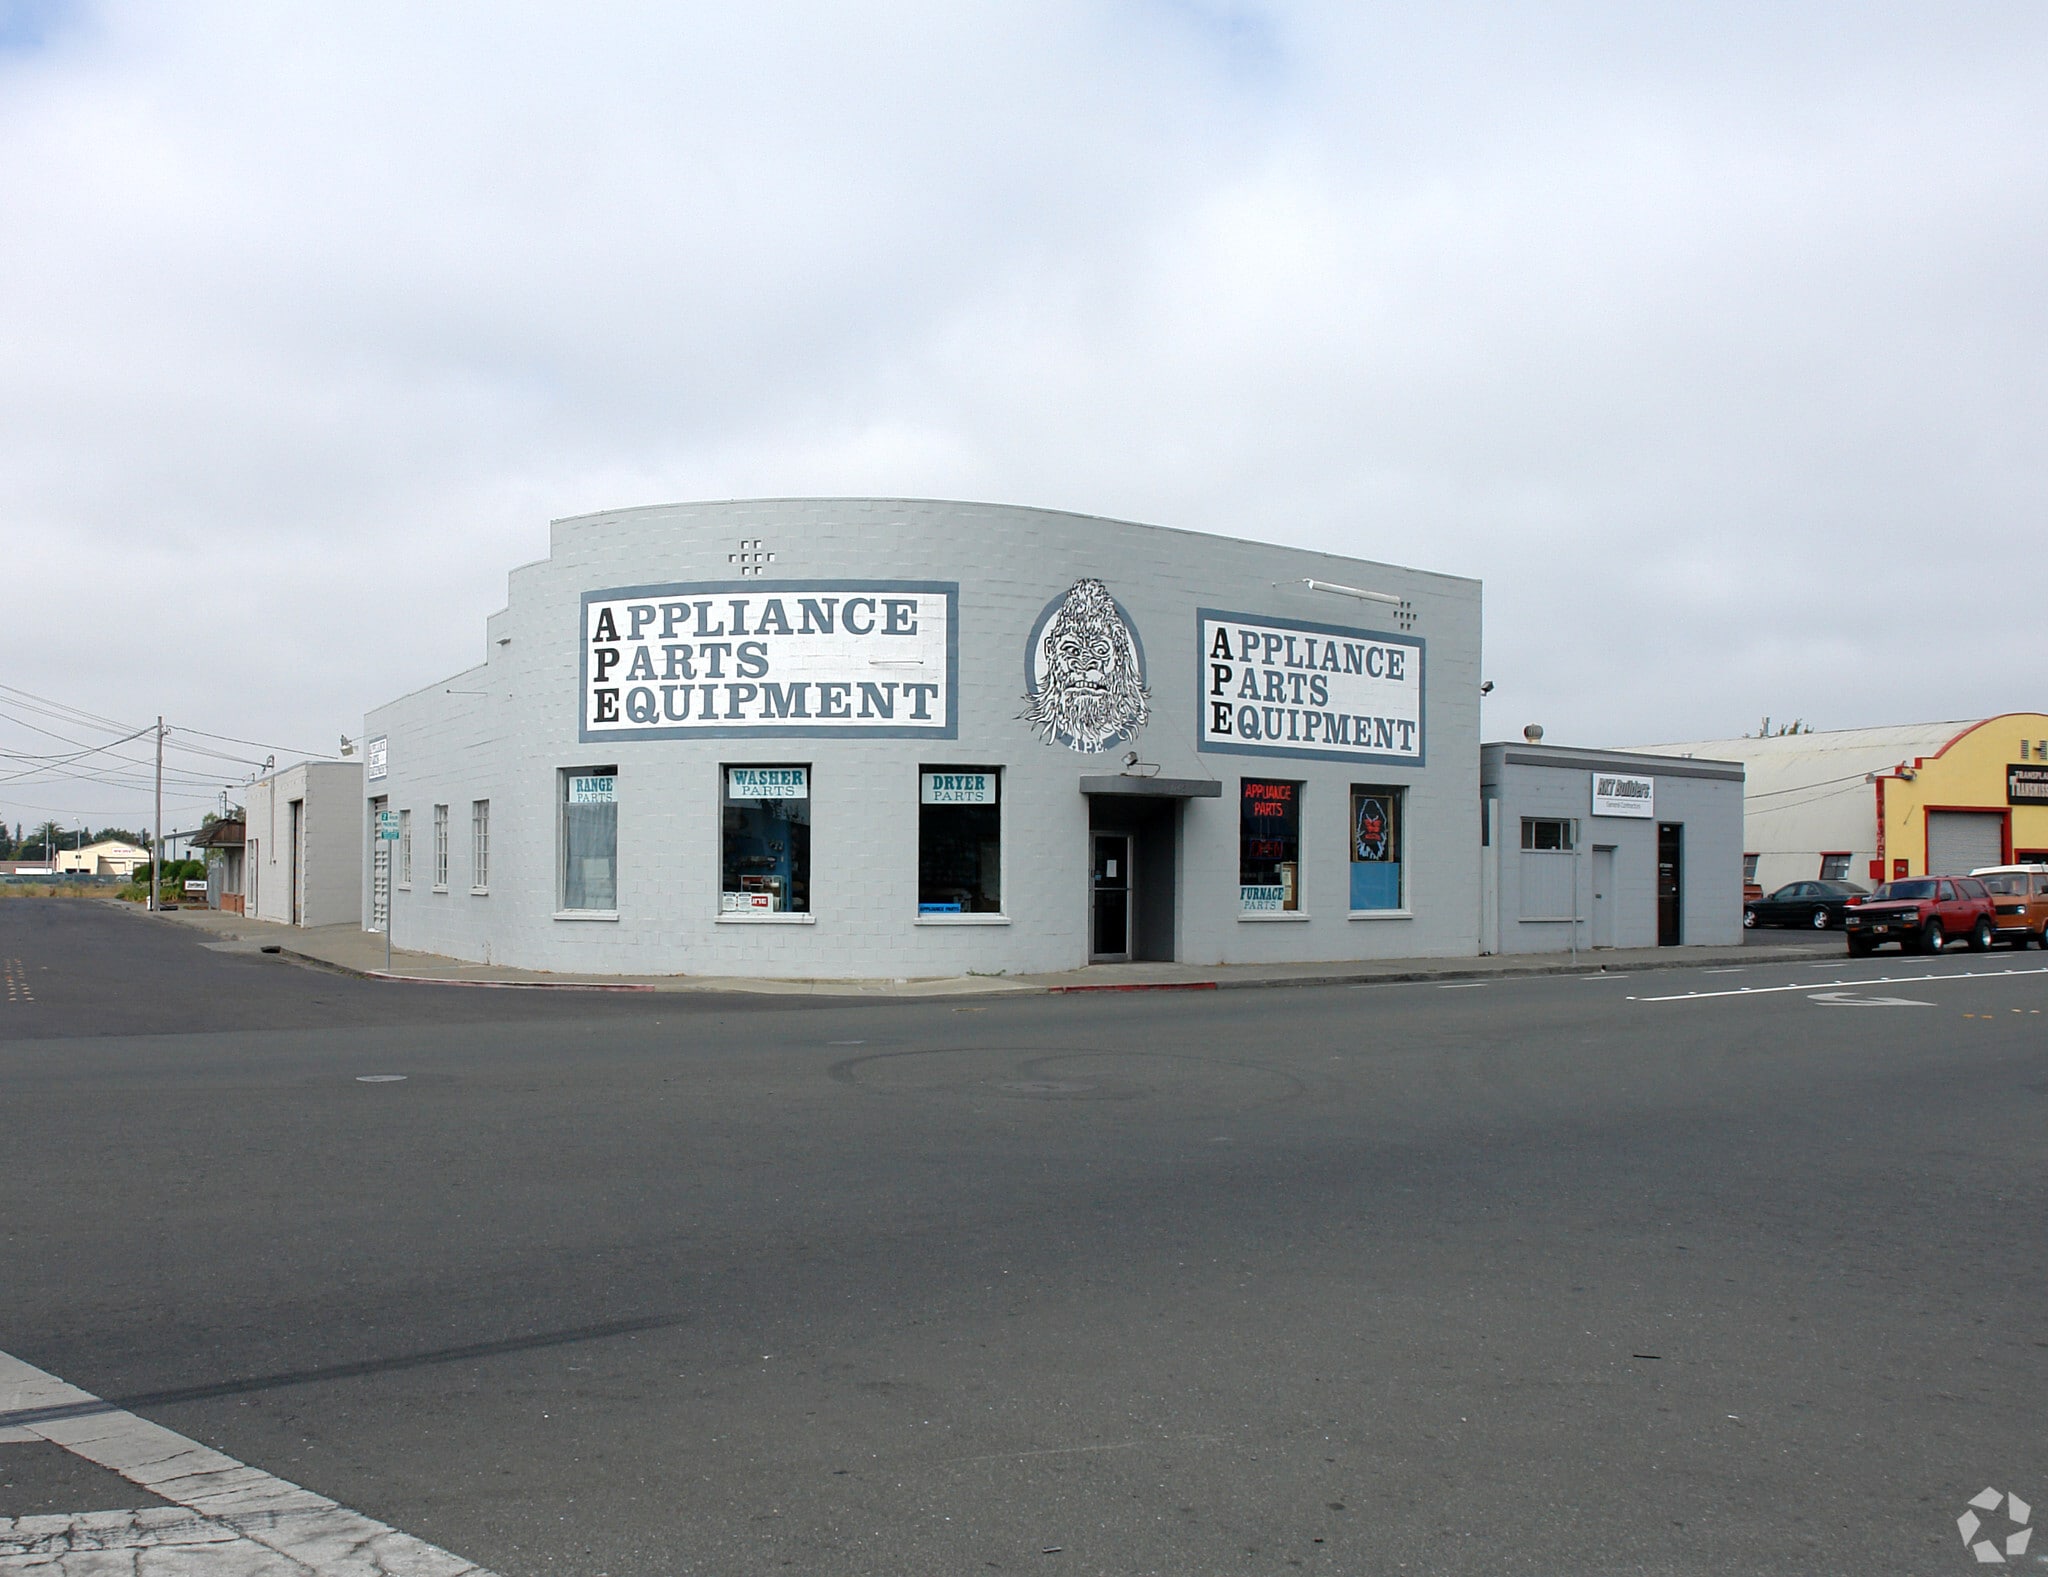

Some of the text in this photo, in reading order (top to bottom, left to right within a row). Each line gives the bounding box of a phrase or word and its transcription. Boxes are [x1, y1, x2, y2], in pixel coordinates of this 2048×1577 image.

[593, 597, 918, 642] APPLIANCE
[593, 641, 769, 682] PARTS
[1210, 627, 1404, 681] APPLIANCE
[1210, 663, 1329, 707] PARTS
[593, 682, 938, 724] EQUIPMENT
[1210, 701, 1415, 751] EQUIPMENT
[576, 777, 613, 792] RANGE
[733, 770, 803, 785] WASHER
[932, 775, 985, 790] DRYER
[577, 793, 613, 803] PARTS
[742, 785, 795, 797] PARTS
[934, 790, 984, 802] PARTS
[1245, 784, 1291, 800] APPLIANCE
[1254, 801, 1284, 816] PARTS
[1251, 841, 1282, 857] OPEN
[1240, 887, 1284, 900] FURNACE
[1244, 900, 1277, 910] PARTS
